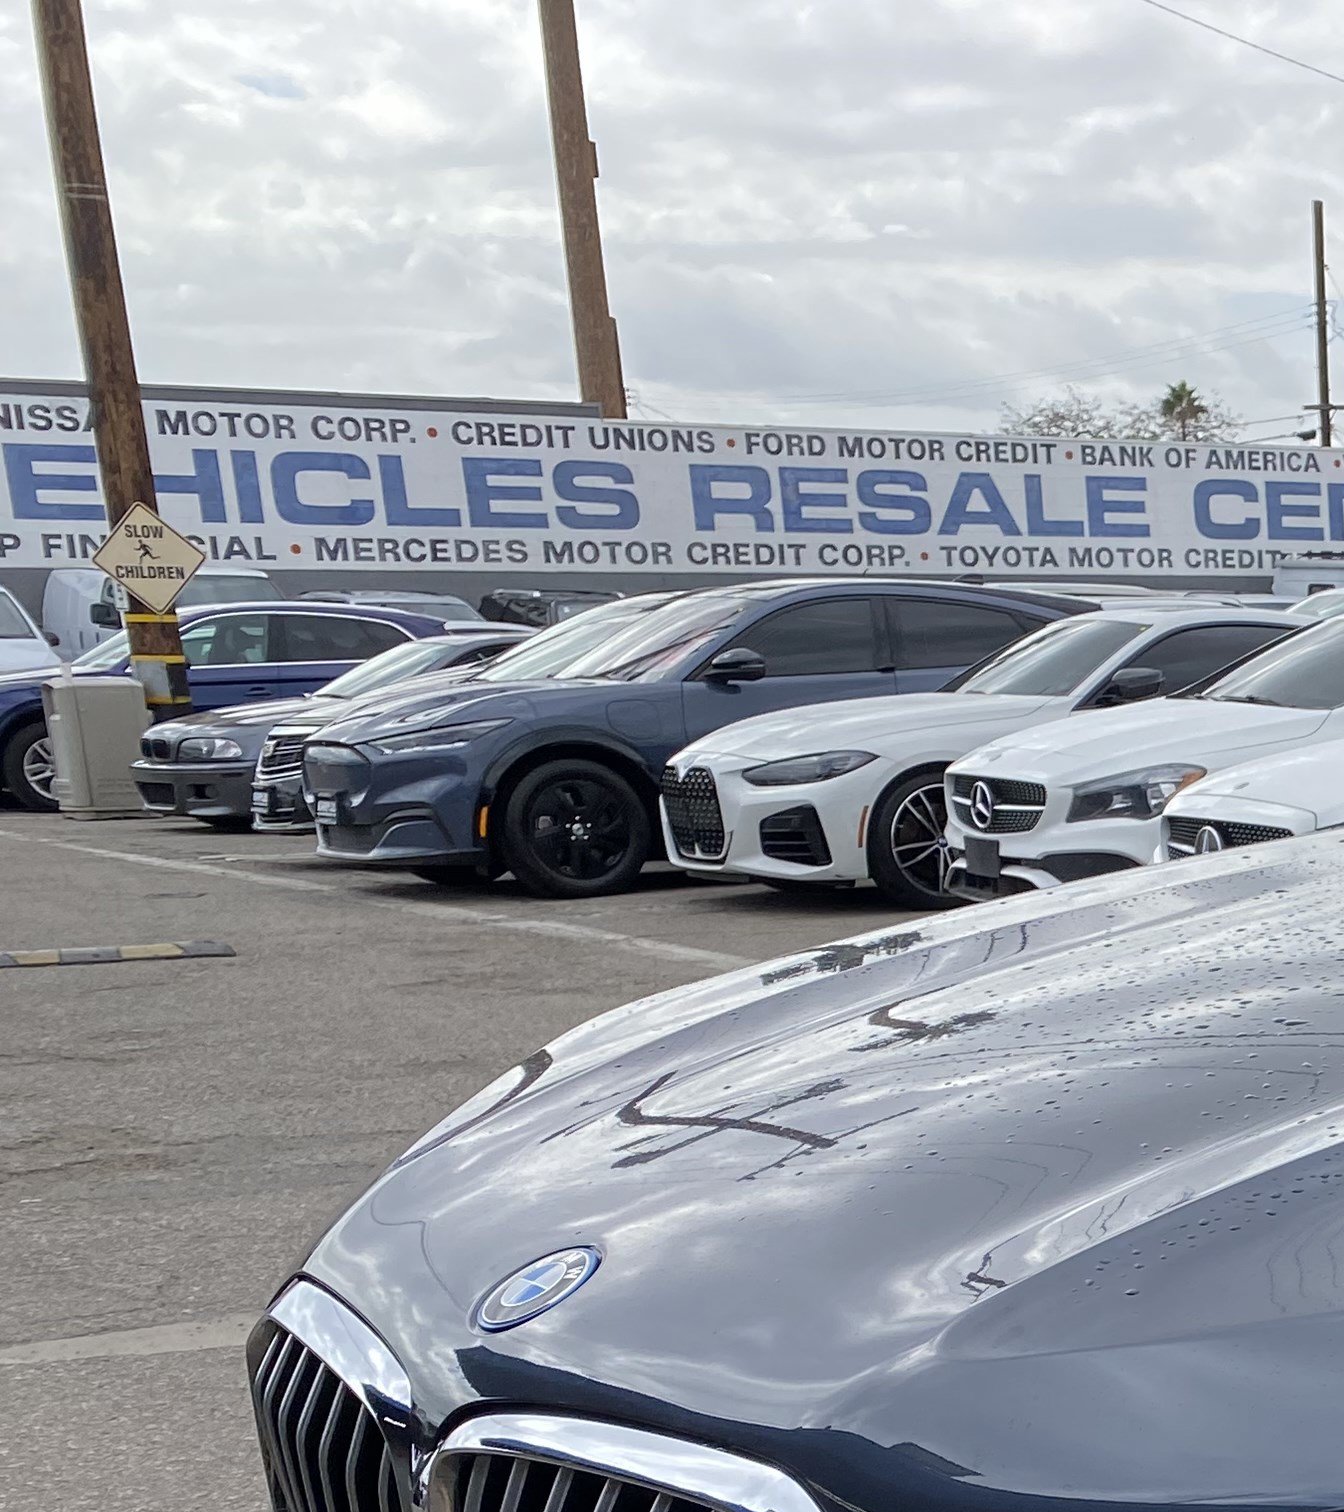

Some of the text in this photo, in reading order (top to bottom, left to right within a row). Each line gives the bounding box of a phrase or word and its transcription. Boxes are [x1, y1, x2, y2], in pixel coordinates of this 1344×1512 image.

[0, 403, 92, 432] NISS
[155, 409, 296, 440] MOTOR
[310, 415, 416, 443] CORP.
[451, 421, 575, 449] CREDIT
[588, 426, 715, 453] UNIONS
[745, 432, 826, 456] FORD
[838, 436, 944, 461] MOTOR
[955, 440, 1056, 464] CREDIT
[1080, 445, 1154, 467] BANK
[1165, 448, 1197, 469] OF
[1205, 450, 1320, 473] AMERICA
[689, 464, 1150, 538] RESALE
[124, 524, 163, 539] SLOW
[41, 533, 277, 561] FINIAL
[314, 537, 528, 563] MERCEDES
[543, 540, 672, 565] MOTOR
[687, 542, 806, 566] CREDIT
[818, 543, 910, 567] CORP.
[940, 546, 1059, 568] TOYOTA
[1069, 547, 1173, 568] MOTOR
[1185, 548, 1284, 569] CREDIT
[115, 565, 185, 580] CHILDREN
